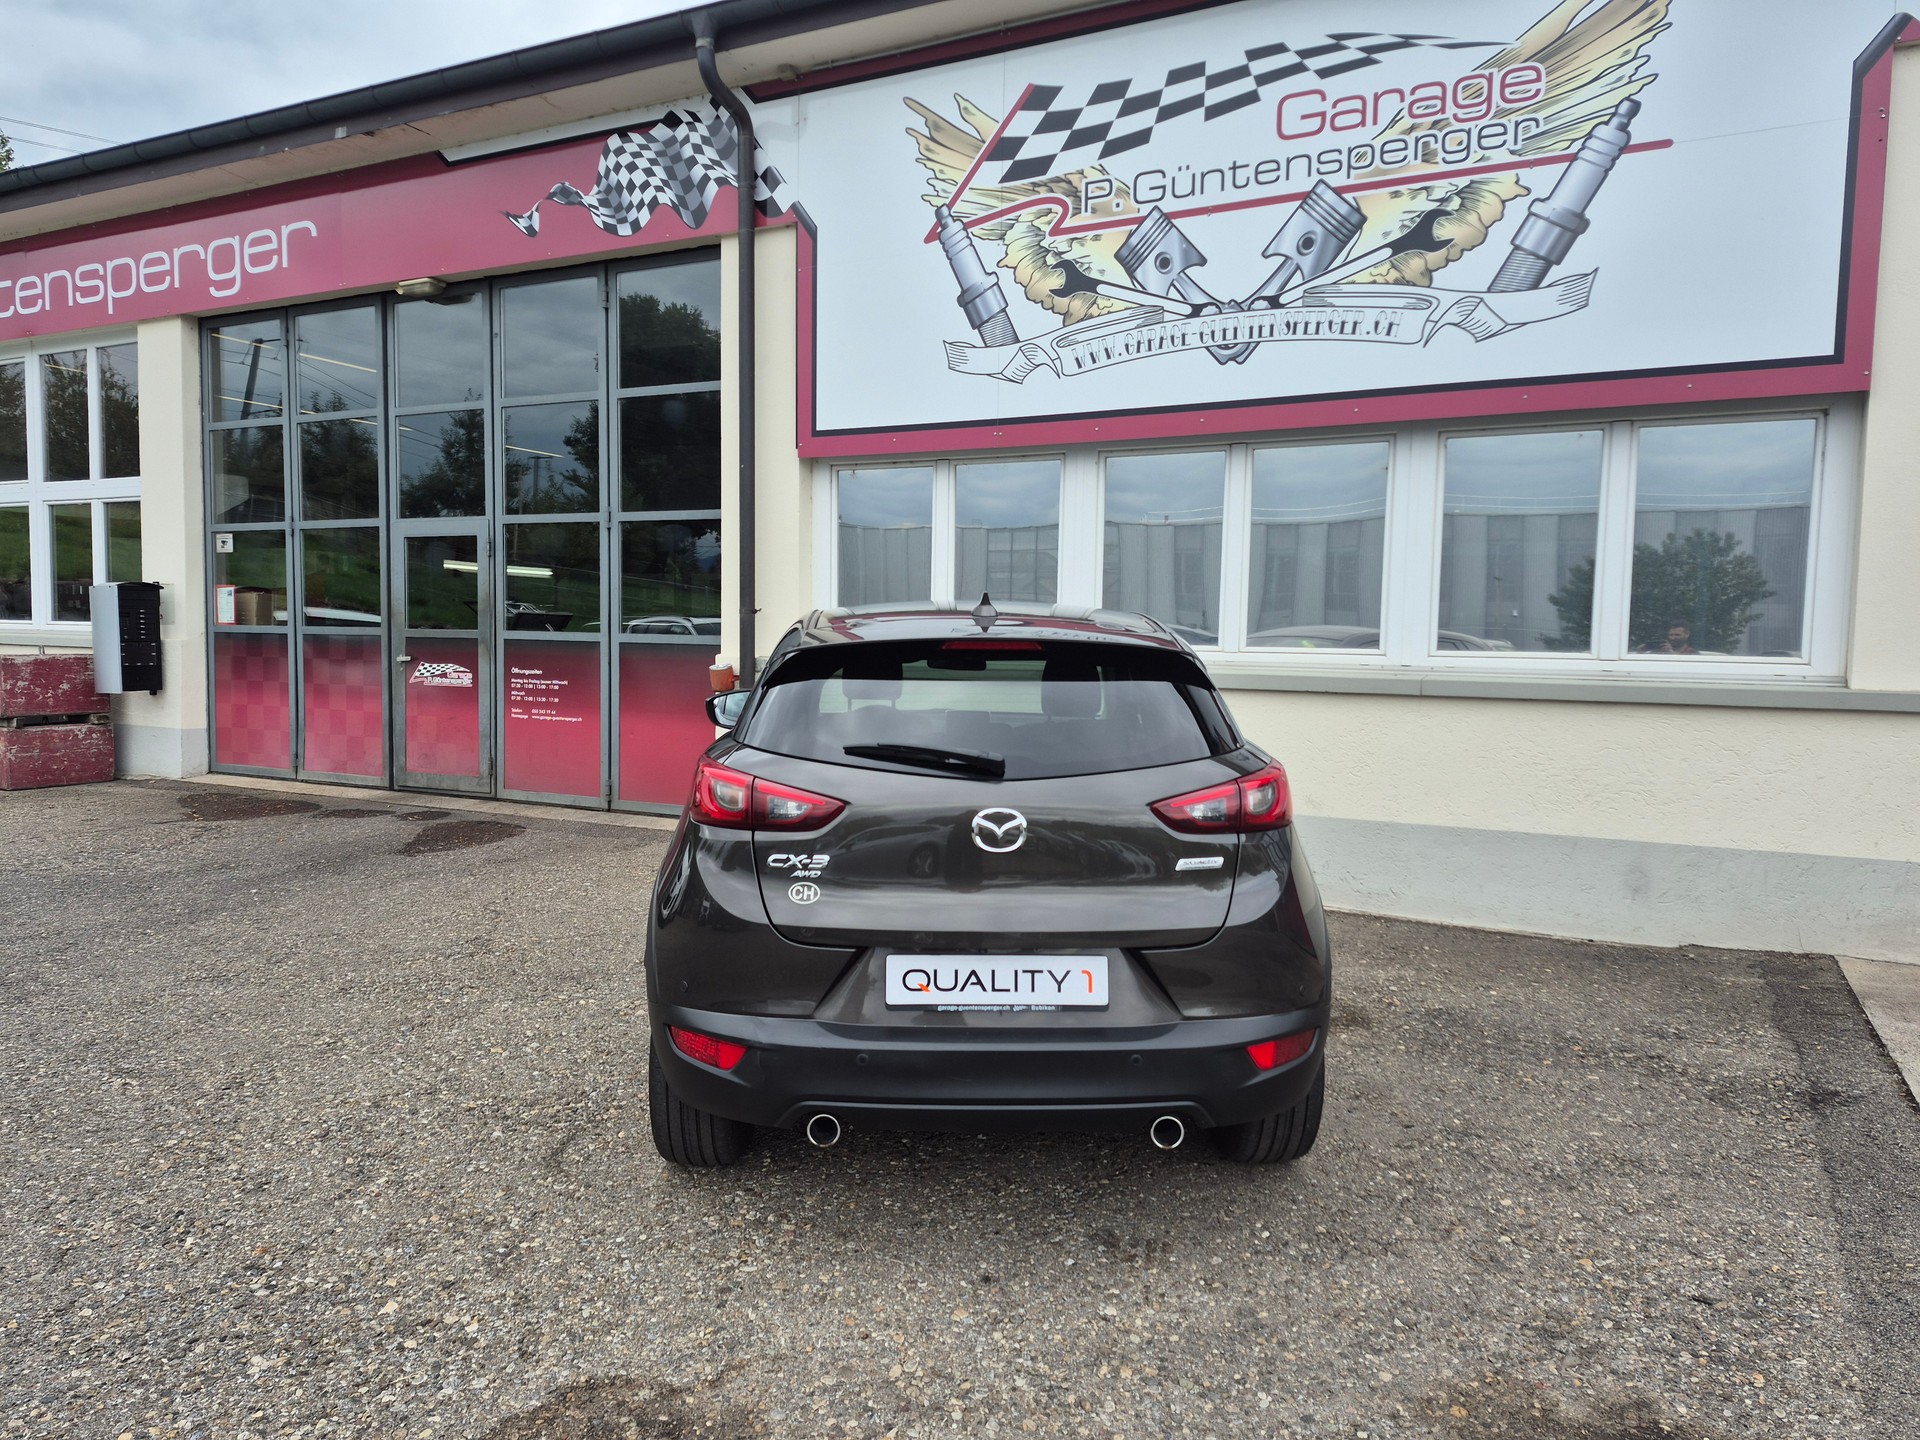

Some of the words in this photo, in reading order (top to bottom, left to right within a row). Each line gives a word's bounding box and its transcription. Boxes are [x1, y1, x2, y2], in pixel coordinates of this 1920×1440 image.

[1275, 64, 1546, 141] Garage
[1084, 177, 1122, 213] P.
[1132, 117, 1541, 206] Güntensperger
[1071, 308, 1405, 370] WWW.GARAGE-GUENTENSPERGER.CH
[767, 854, 831, 869] CX-3
[790, 870, 822, 878] AWD
[792, 885, 815, 901] CH
[902, 968, 1072, 993] QUALITY
[1081, 969, 1094, 994] 1
